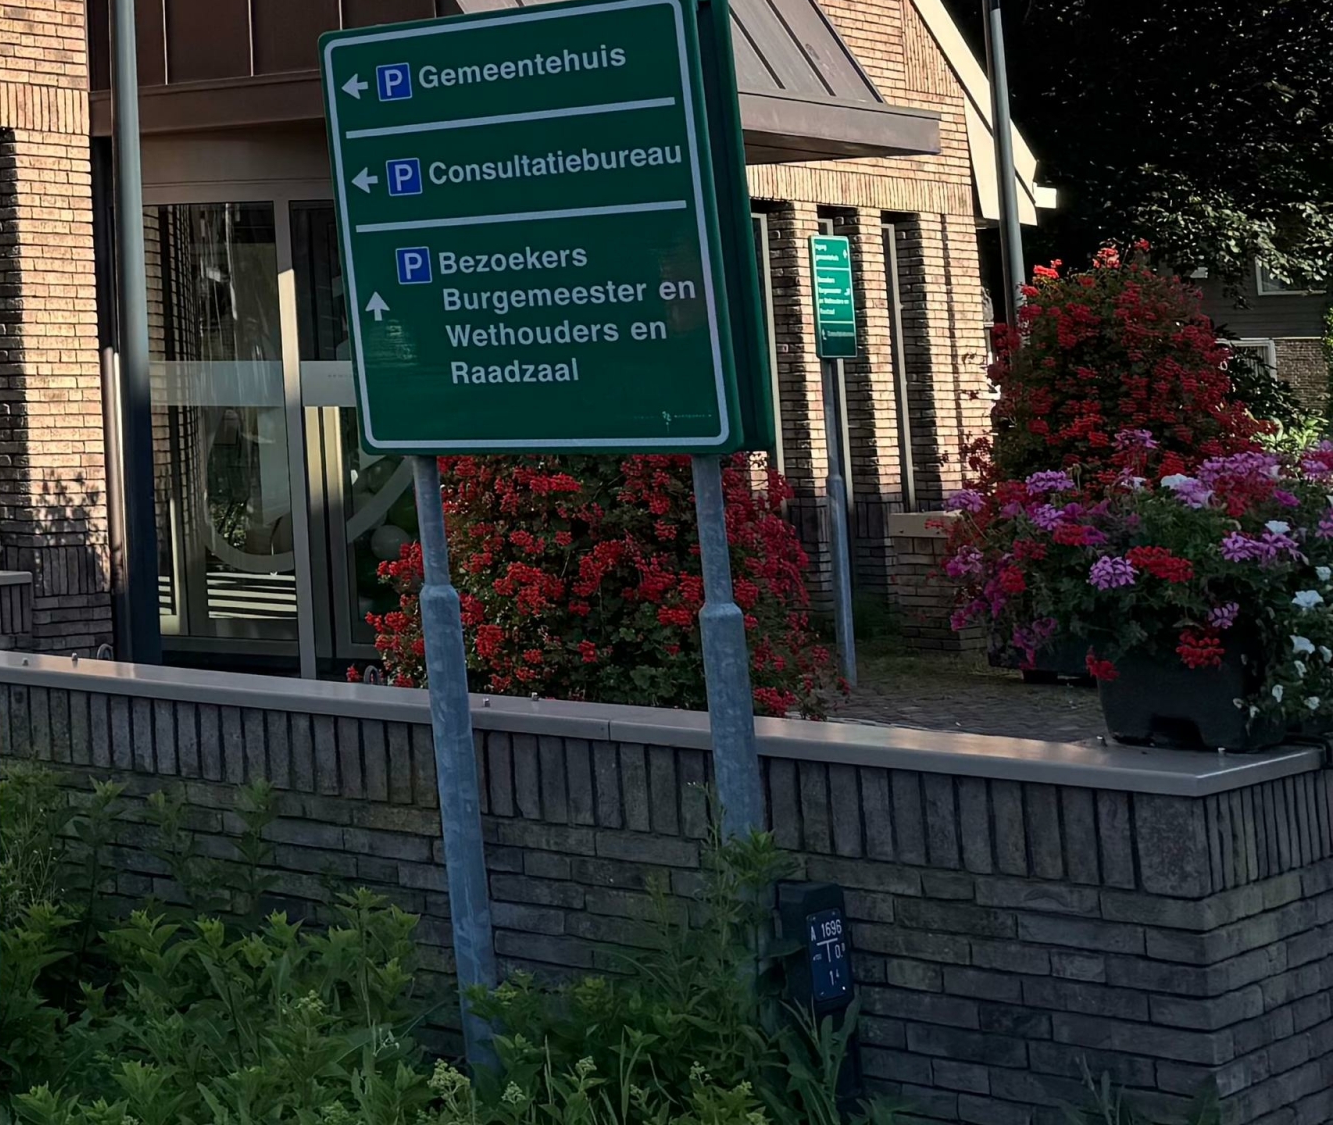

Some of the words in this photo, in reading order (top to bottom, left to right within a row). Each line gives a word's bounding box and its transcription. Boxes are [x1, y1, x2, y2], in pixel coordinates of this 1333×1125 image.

[385, 68, 404, 95] P
[418, 44, 627, 89] Gemeentehuis
[395, 164, 414, 190] P
[428, 143, 683, 185] Consultatiebureau
[404, 253, 423, 279] P
[438, 245, 588, 274] Bezoekers
[443, 278, 647, 315] Burgemeester
[659, 279, 696, 301] en
[445, 318, 620, 348] Wethouders
[631, 319, 667, 340] en
[450, 357, 579, 384] Raadzaal
[810, 926, 816, 941] A
[821, 919, 842, 938] 1696
